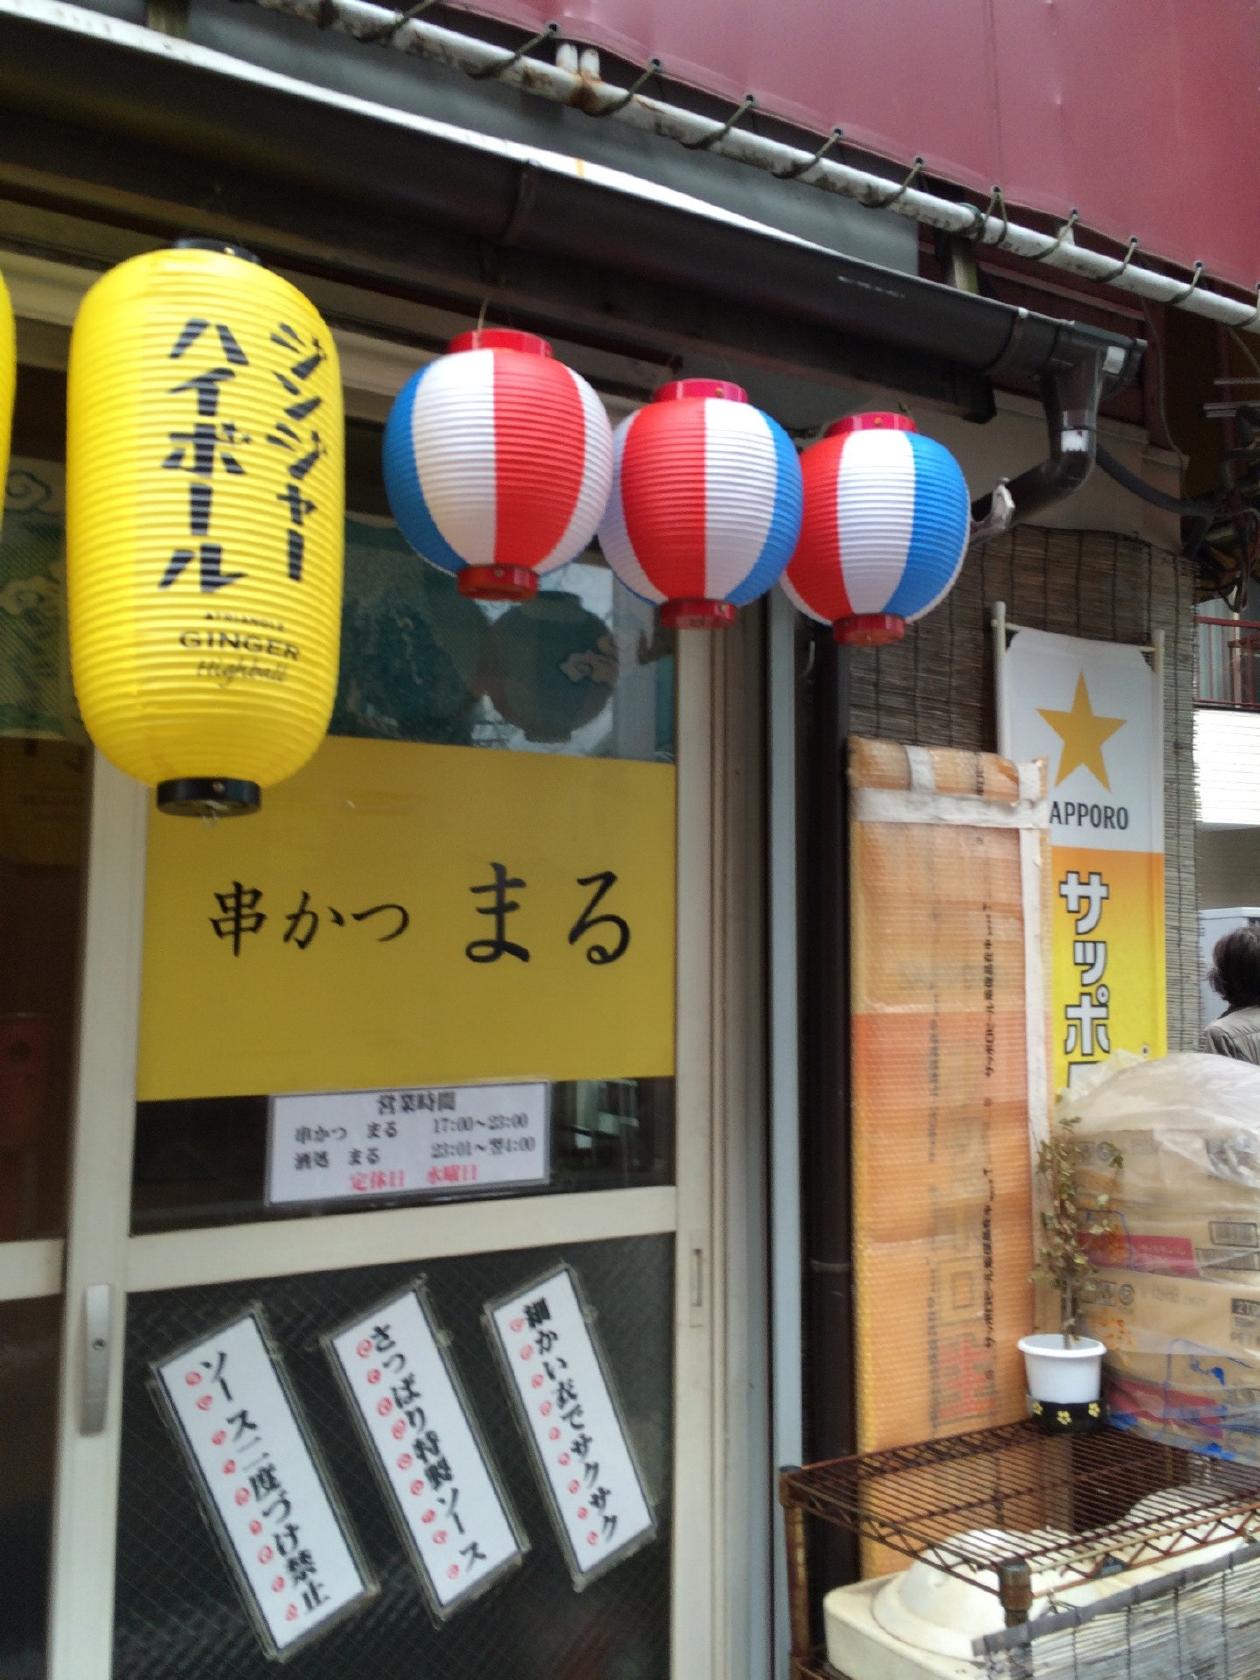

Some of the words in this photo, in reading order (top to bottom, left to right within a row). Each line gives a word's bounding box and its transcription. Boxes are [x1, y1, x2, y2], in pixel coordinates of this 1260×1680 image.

[159, 319, 252, 593] ハイボール
[267, 322, 329, 581] ジンジャー
[179, 631, 300, 661] GINGER
[197, 656, 287, 688] Highball
[1050, 801, 1129, 830] APPORO
[209, 881, 410, 957] 串かつ
[466, 862, 630, 965] まる
[377, 1091, 456, 1115] 営業時間
[295, 1125, 347, 1144] 串かつ
[367, 1121, 397, 1139] まる
[349, 1148, 380, 1166] まる
[350, 1169, 405, 1192] 定休日
[427, 1164, 477, 1185] 水曜日
[524, 1297, 619, 1542] 細かい衣でサクサク
[201, 1351, 331, 1614] ソース二度づけ禁止
